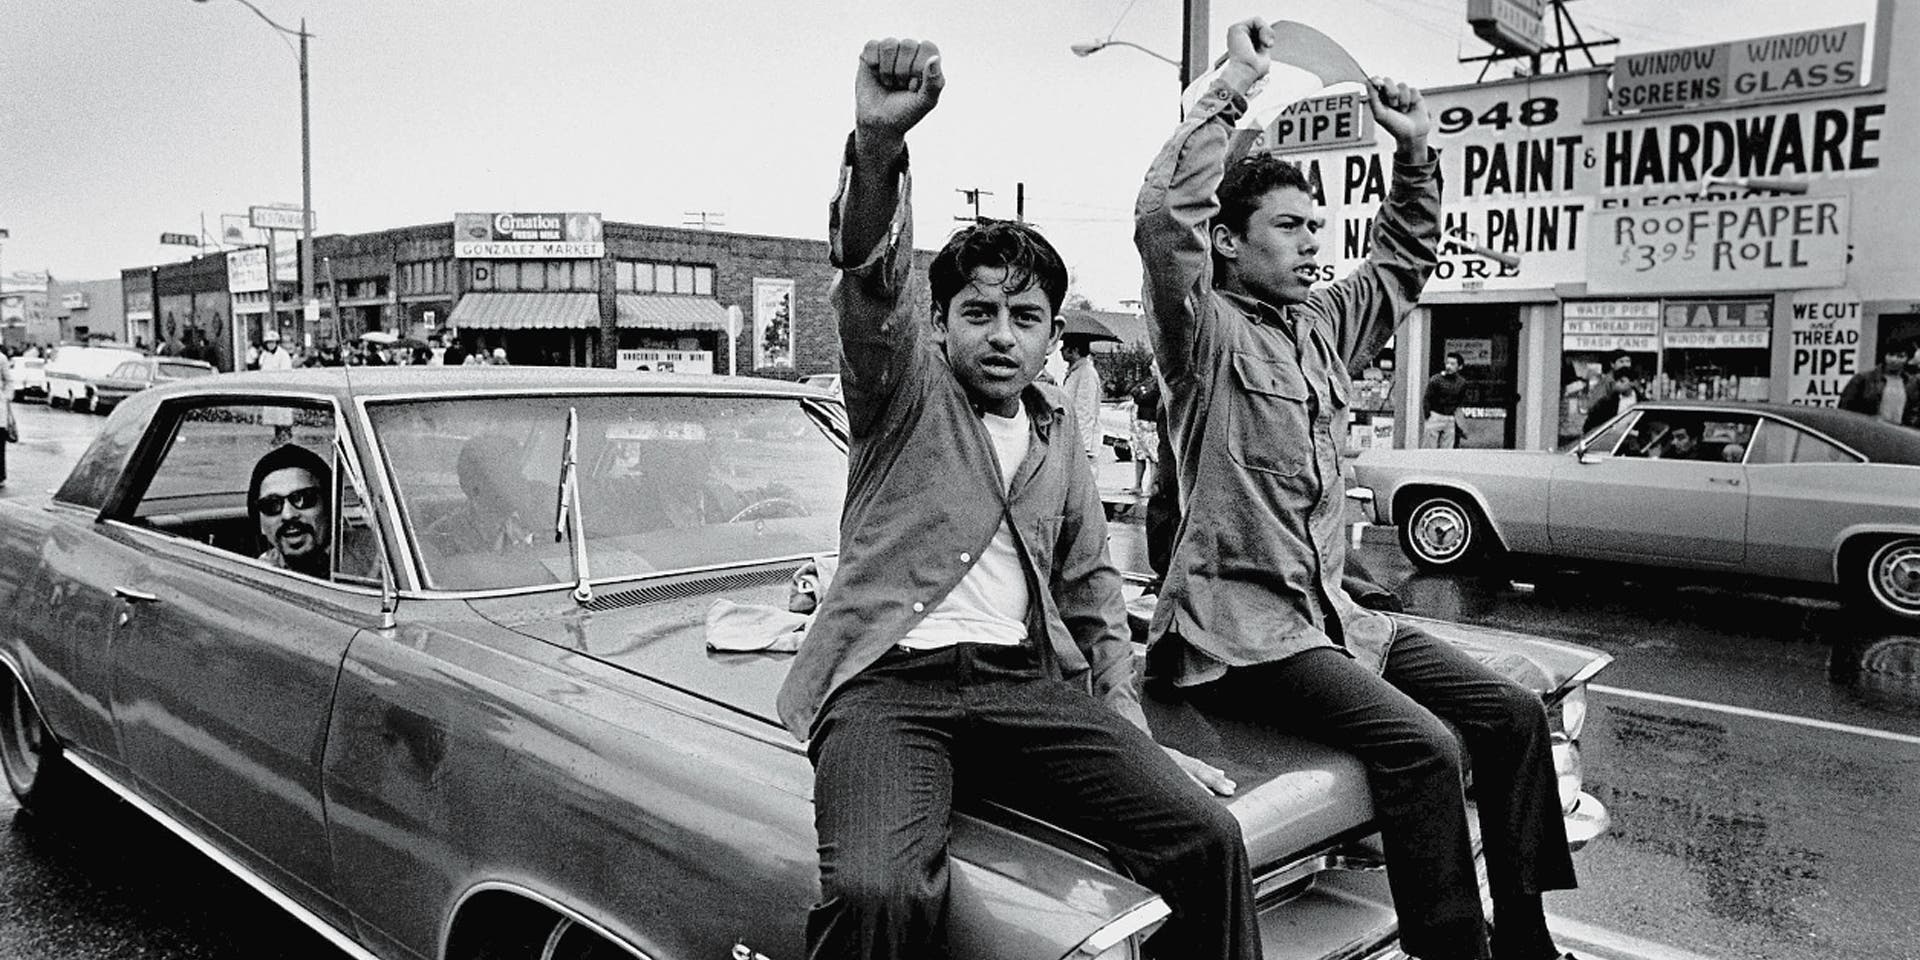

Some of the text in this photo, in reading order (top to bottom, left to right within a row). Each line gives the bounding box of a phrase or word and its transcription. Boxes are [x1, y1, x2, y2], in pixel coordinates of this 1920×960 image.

[1747, 31, 1847, 63] WINDOW
[1628, 48, 1716, 77] WINDOW
[1734, 61, 1856, 96] GLASS
[1617, 77, 1721, 108] SCREENS
[1438, 97, 1559, 134] 948
[1278, 112, 1351, 145] PIPE
[1463, 135, 1583, 197] PAINT
[1584, 149, 1596, 169] &
[1604, 104, 1886, 187] HARDWARE
[495, 213, 560, 234] Carnation
[1487, 204, 1584, 254] PAINT
[463, 244, 598, 256] GONZALEZ MARKET
[1713, 239, 1808, 271] ROLL
[476, 268, 488, 281] D
[1576, 305, 1649, 316] WATER PIPE
[1665, 303, 1769, 328] SALE
[1792, 302, 1860, 320] WE CUT
[1568, 321, 1656, 332] WE THREAD PIPE
[1792, 330, 1859, 346] THREAD
[1576, 337, 1649, 348] TRASH CANS
[1667, 333, 1764, 345] WINDOW GLASS
[1793, 348, 1856, 376] PIPE
[1806, 379, 1843, 397] ALL
[1461, 408, 1486, 419] PEN
